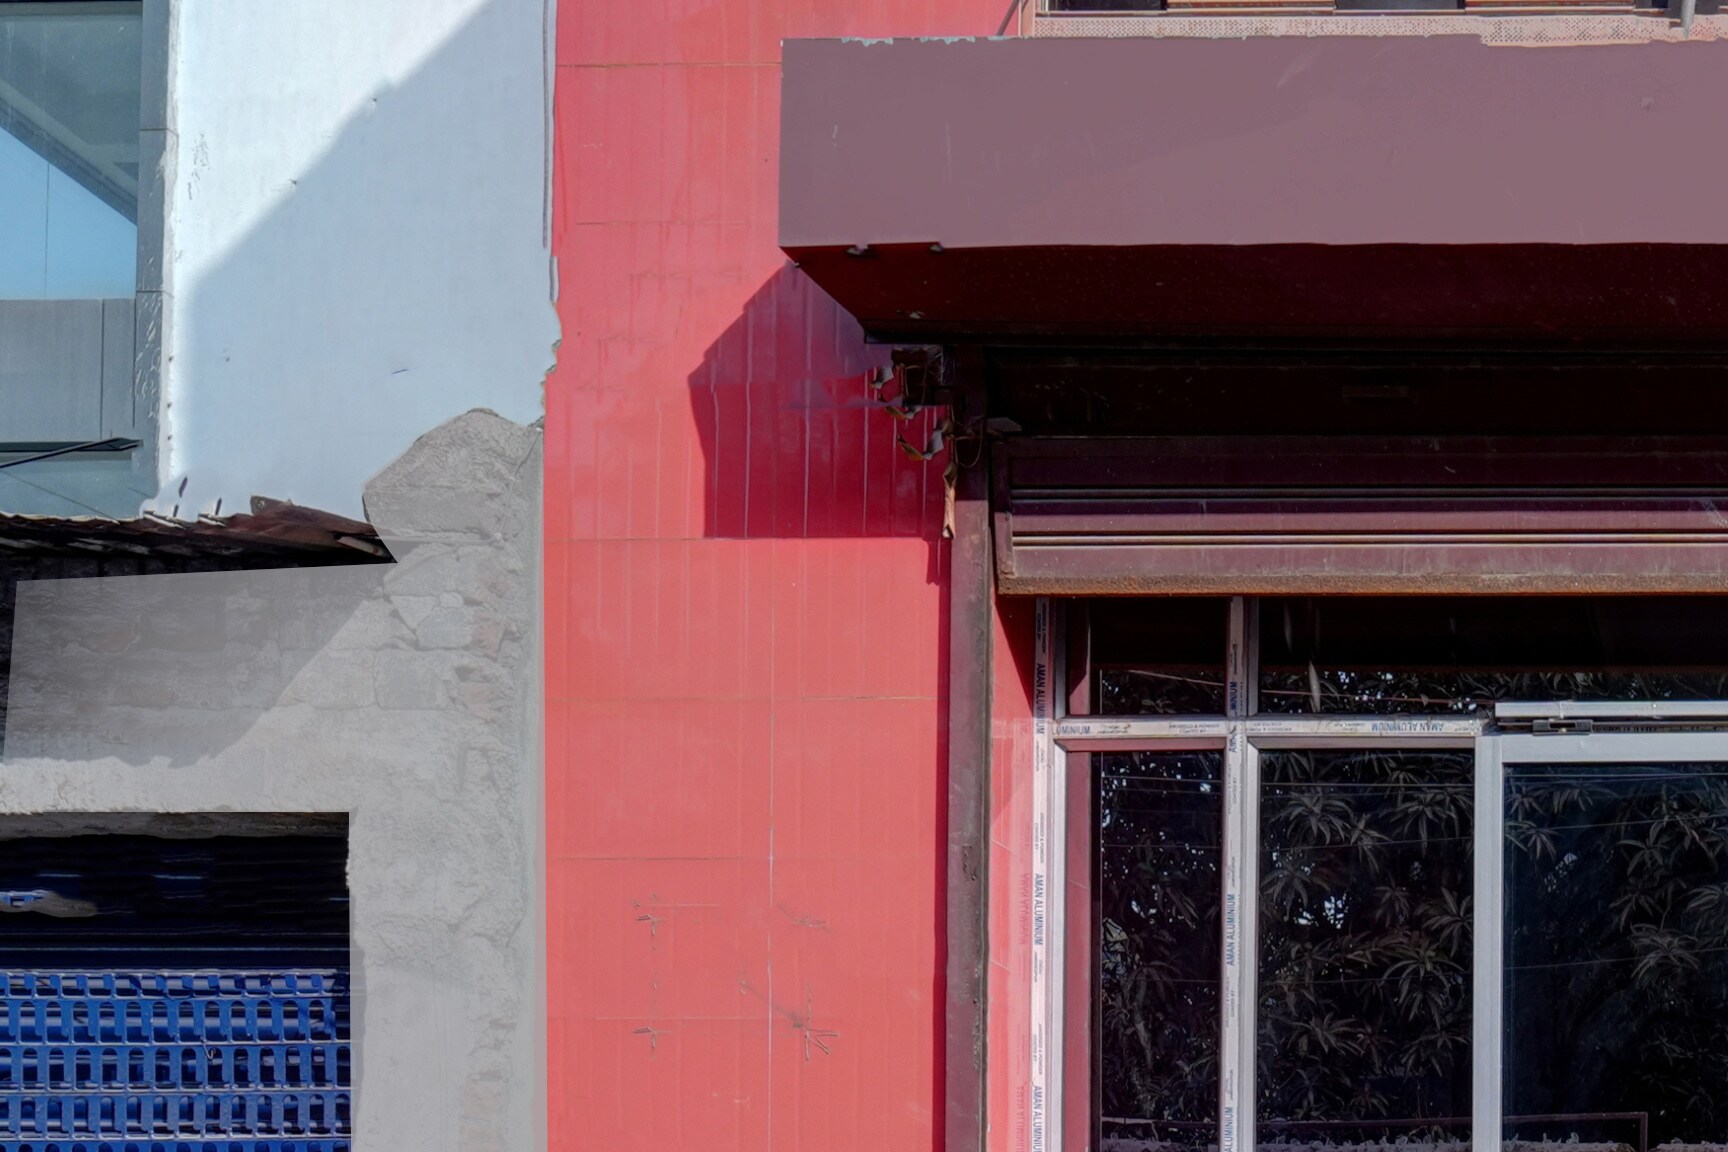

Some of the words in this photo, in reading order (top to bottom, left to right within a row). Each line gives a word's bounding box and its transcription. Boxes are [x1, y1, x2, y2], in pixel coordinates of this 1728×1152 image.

[1036, 664, 1045, 688] AMAN
[1035, 690, 1045, 734] ALUMINIUM
[1034, 874, 1043, 897] AMAN
[1034, 899, 1043, 945] ALUMINIUM
[1227, 894, 1235, 940] ALUMINIUM
[1227, 941, 1235, 965] AMAN
[1033, 1085, 1042, 1110] AMAN
[1224, 1106, 1233, 1152] ALUMINIUM
